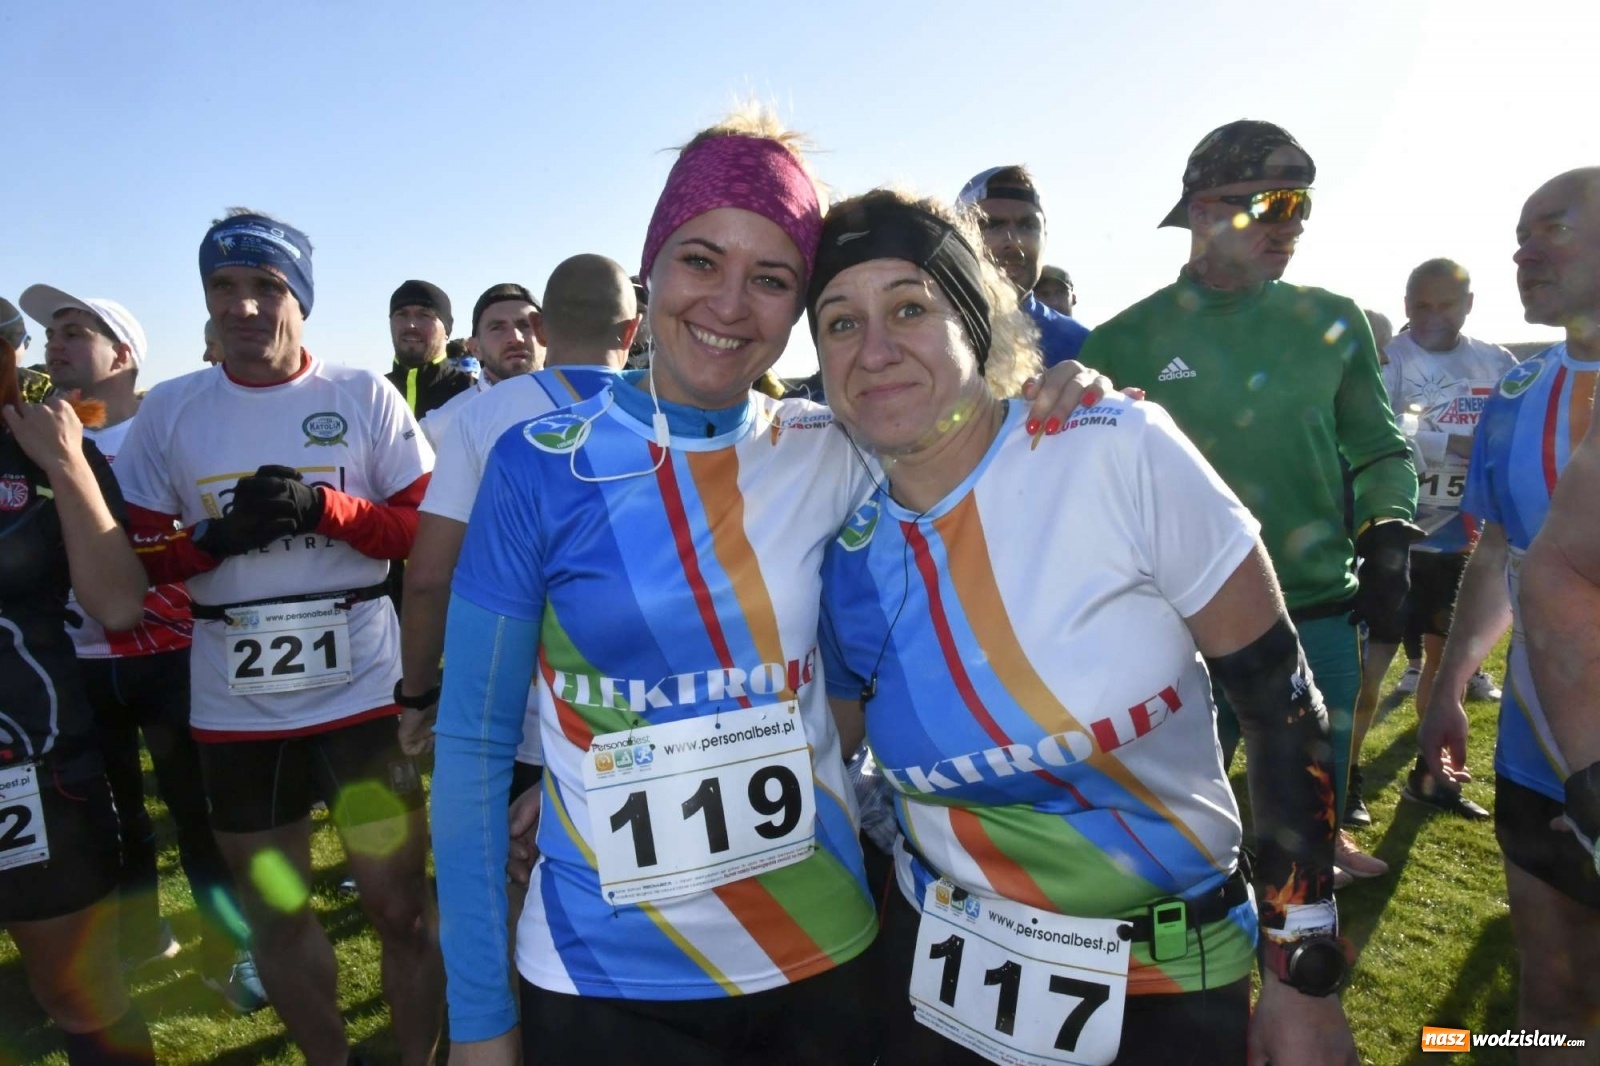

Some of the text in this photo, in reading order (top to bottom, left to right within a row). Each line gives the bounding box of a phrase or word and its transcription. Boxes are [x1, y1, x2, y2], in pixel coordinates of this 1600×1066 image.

[1158, 369, 1197, 382] adidas
[1060, 416, 1118, 432] UBOMIA
[1458, 397, 1486, 412] ENER
[233, 629, 338, 680] 221
[552, 647, 817, 713] ELEKTROLE
[664, 718, 795, 756] www.personalbest.pl
[609, 764, 803, 869] 119
[988, 910, 1121, 955] www.personalbest.pl
[928, 933, 1112, 1054] 117
